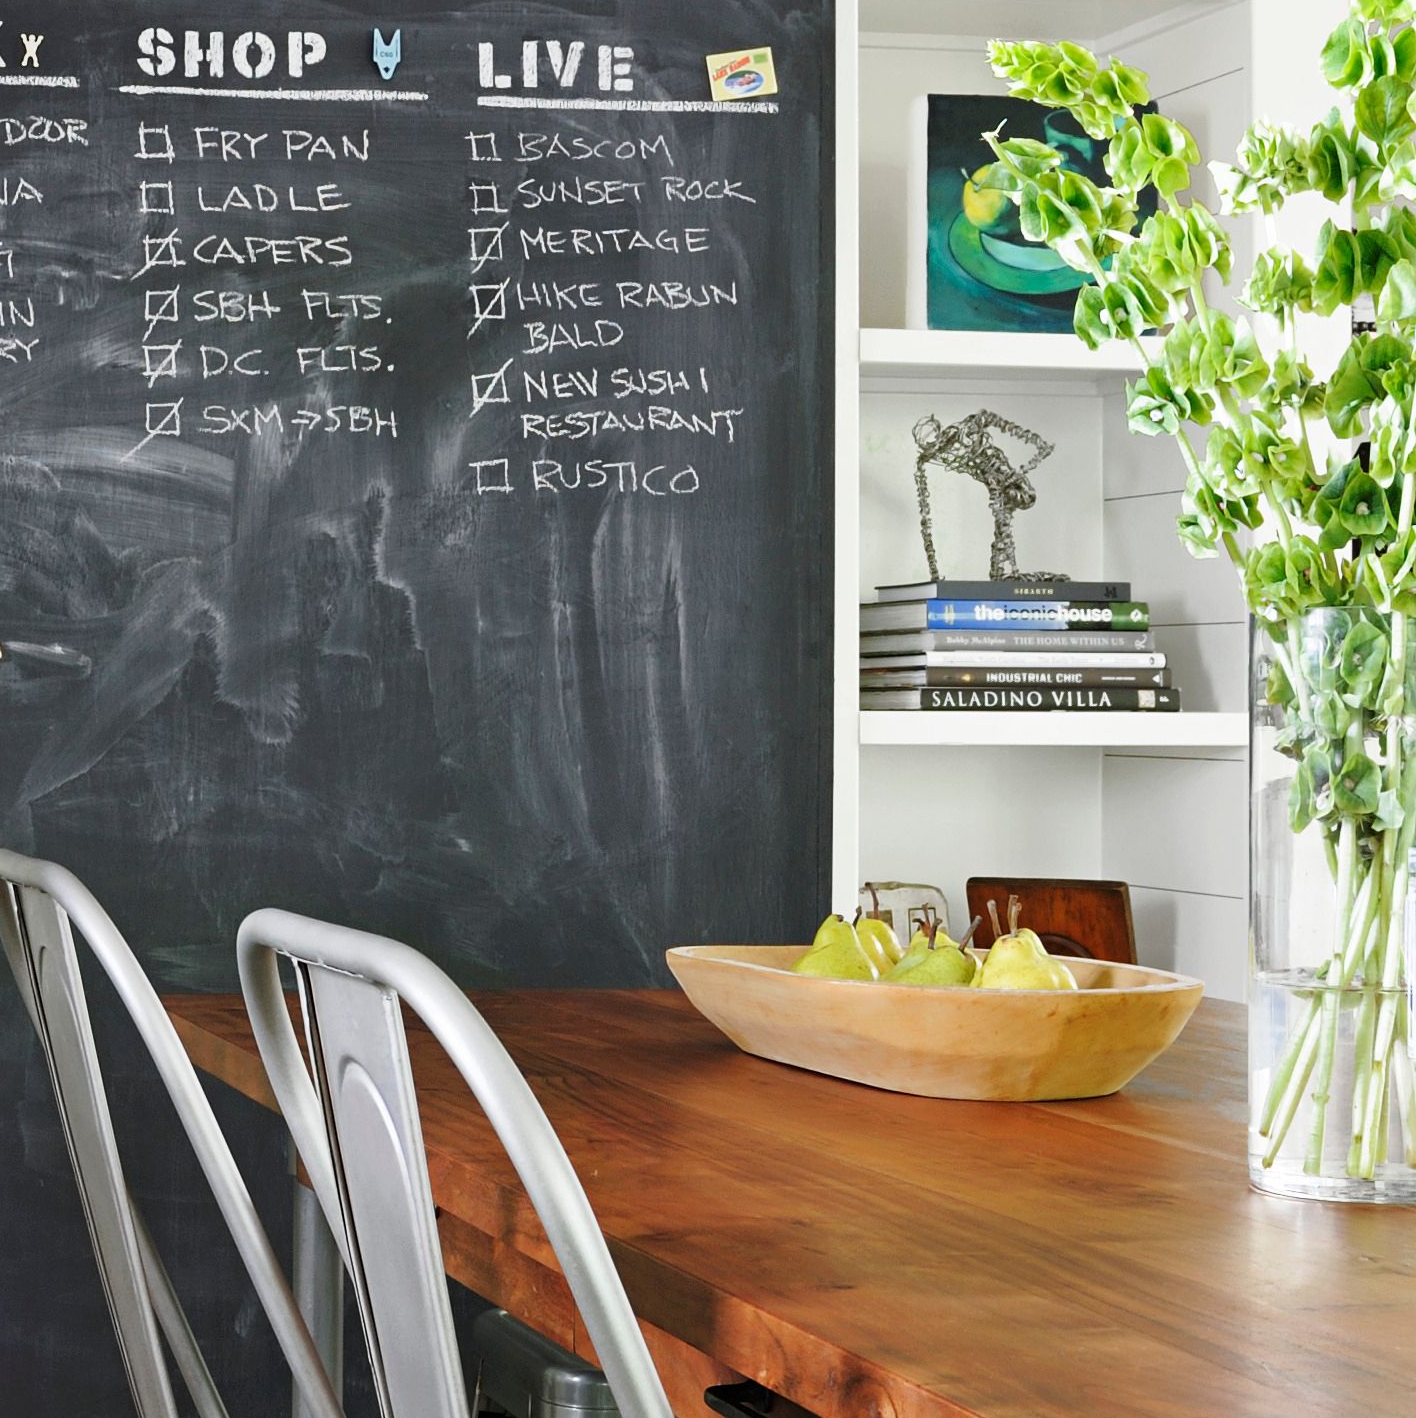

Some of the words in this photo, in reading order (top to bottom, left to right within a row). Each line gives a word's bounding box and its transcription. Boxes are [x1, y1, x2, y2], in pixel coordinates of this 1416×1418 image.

[136, 27, 327, 79] SHOP
[478, 40, 634, 92] LIVE
[193, 127, 269, 162] FRY
[282, 129, 369, 162] PAN
[514, 132, 674, 166] BASCOM
[198, 183, 352, 212] LADLE
[517, 176, 648, 209] SUNSET
[661, 176, 757, 204] ROCK
[193, 235, 353, 267] CAPERS
[520, 226, 710, 261] MERITAGE
[193, 290, 281, 322] SBH
[301, 288, 393, 324] FLTS.
[516, 282, 604, 310] HIKE
[616, 281, 738, 310] RABUN
[522, 319, 624, 354] BALD
[199, 344, 270, 379] D.C.
[296, 345, 395, 374] FLTS.
[524, 368, 598, 403] NEW
[610, 367, 709, 399] SUSHI
[520, 406, 744, 443] RESTAURANT
[532, 459, 700, 496] RUSTICO
[1014, 637, 1033, 645] THE
[1037, 637, 1068, 645] HOME
[1070, 637, 1110, 646] WITHIN
[1111, 637, 1125, 646] US
[986, 673, 1053, 683] INDUSTRIAL
[1055, 673, 1083, 683] CHIC
[932, 691, 1043, 708] SALADINO
[1051, 691, 1113, 707] VILLA
